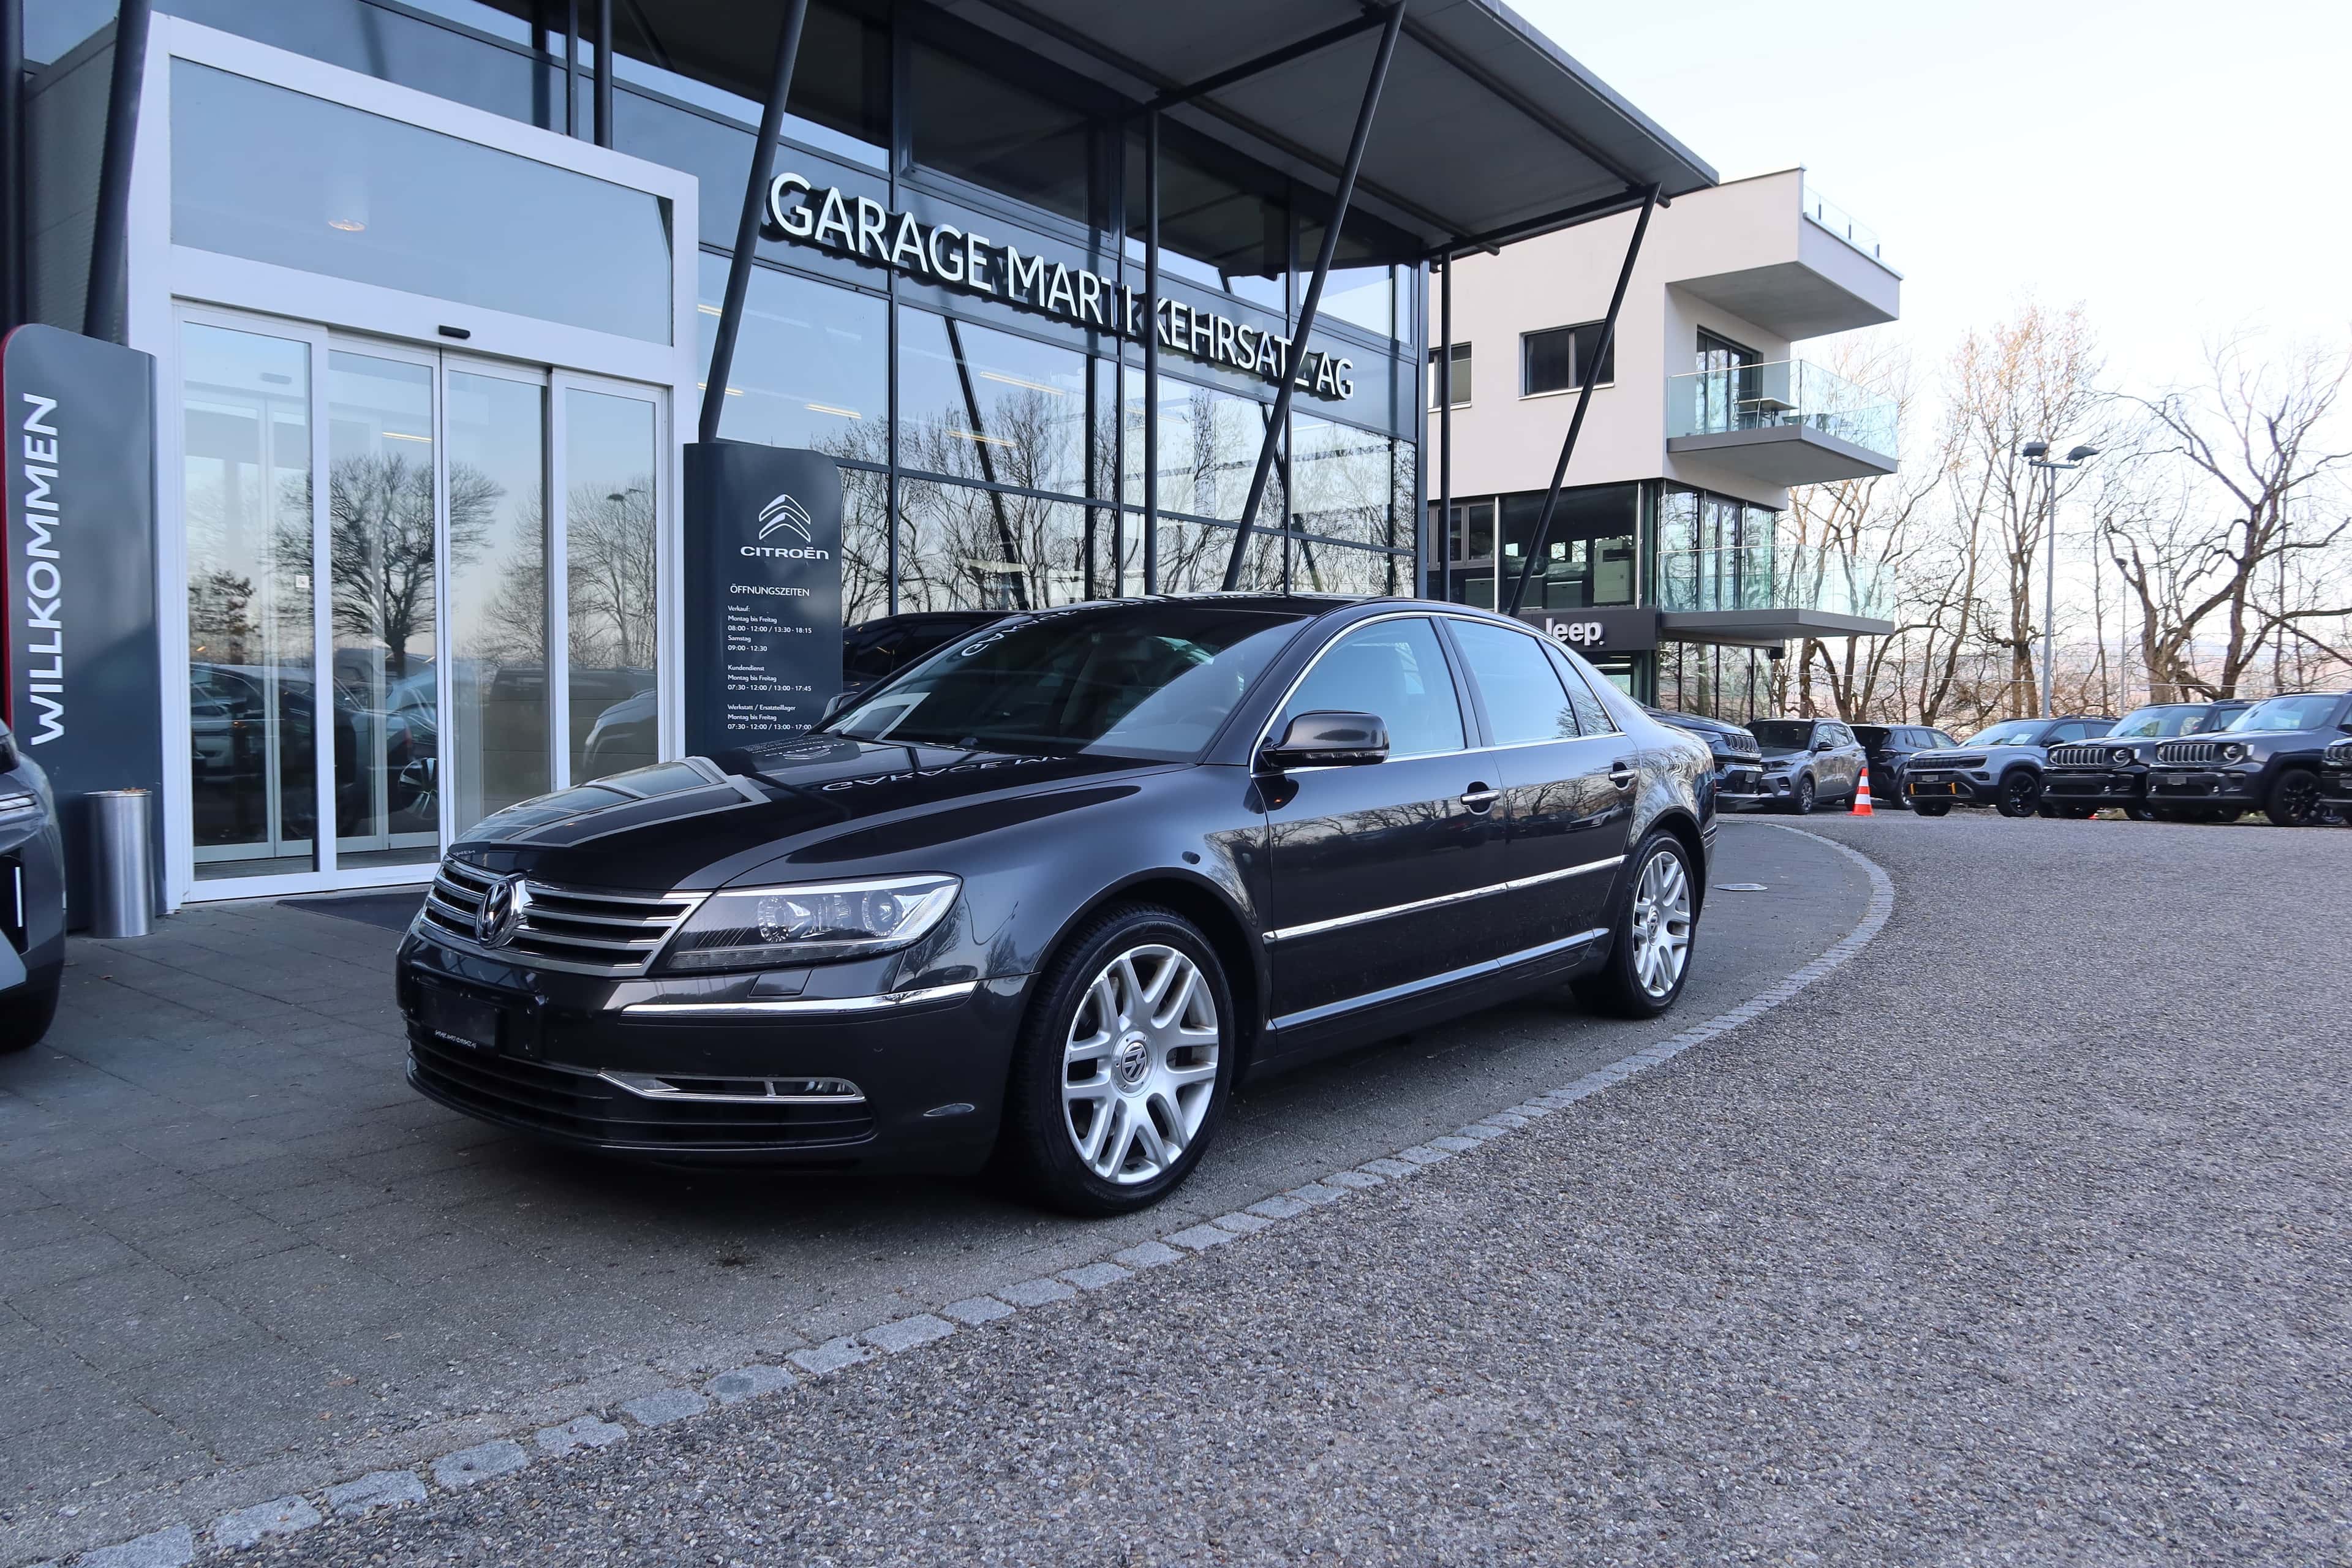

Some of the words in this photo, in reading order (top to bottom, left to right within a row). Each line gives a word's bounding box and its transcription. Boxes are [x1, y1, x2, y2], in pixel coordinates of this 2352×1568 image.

[768, 172, 992, 292] GARAGE
[1006, 245, 1132, 334] MARTI
[1316, 352, 1354, 399] AG
[23, 392, 64, 745] WILLKOMMEN
[730, 583, 810, 597] ÖFFNUNGSZEITEN
